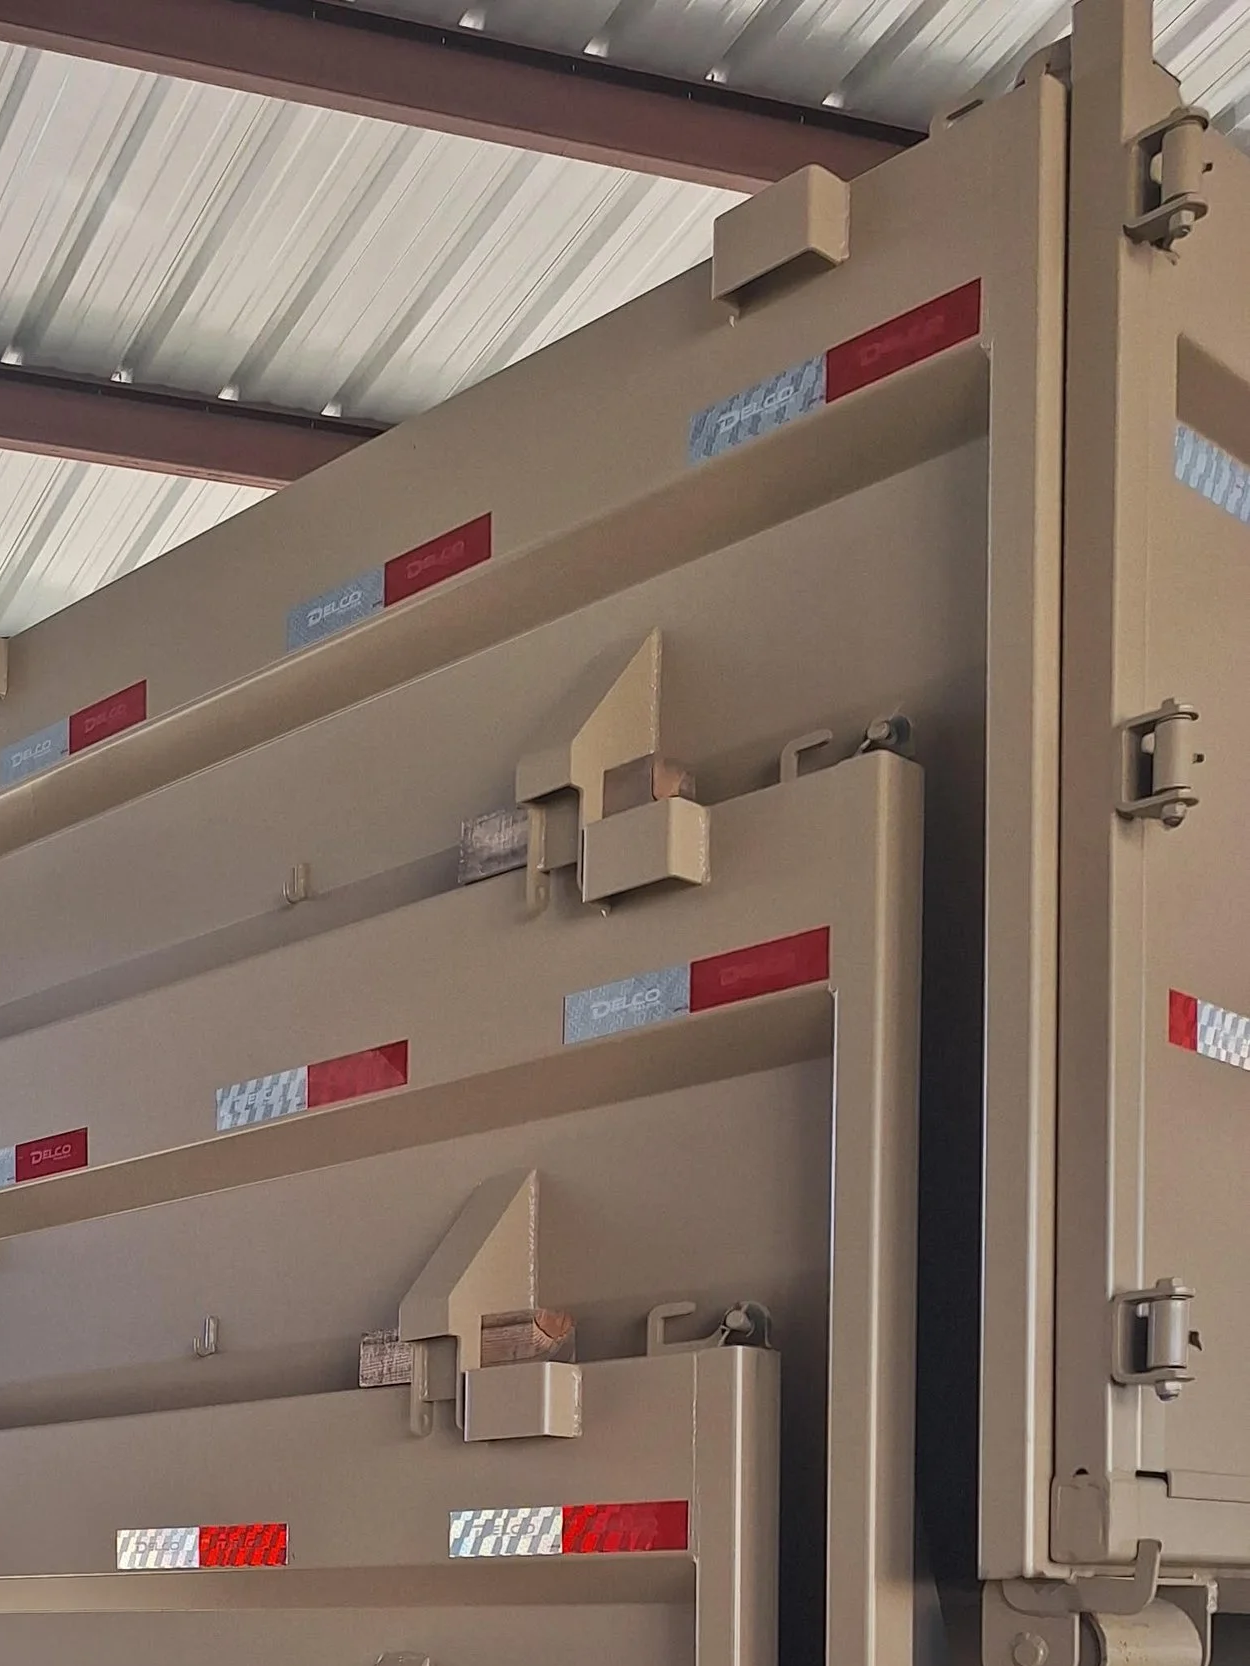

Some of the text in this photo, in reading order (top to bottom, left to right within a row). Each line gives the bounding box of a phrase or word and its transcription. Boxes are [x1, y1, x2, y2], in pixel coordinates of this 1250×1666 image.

[717, 386, 796, 434] DELCO
[406, 541, 465, 580] DELCO
[306, 591, 363, 627] DELCO
[10, 740, 51, 768] DELCO
[591, 988, 660, 1019] DELCO
[30, 1144, 72, 1165] DELCO
